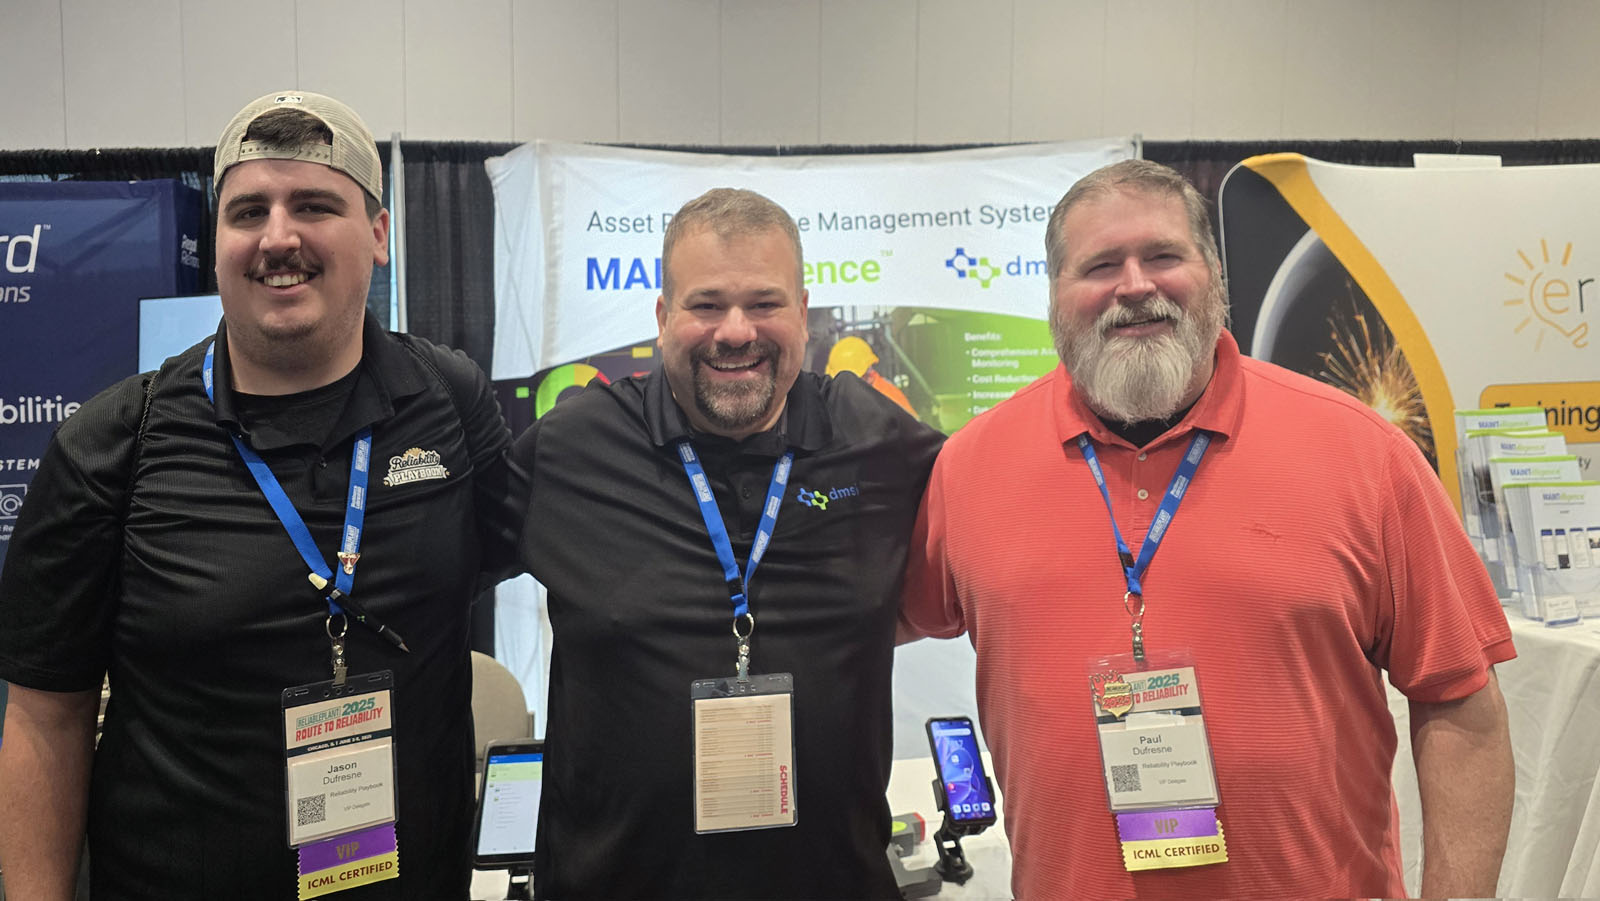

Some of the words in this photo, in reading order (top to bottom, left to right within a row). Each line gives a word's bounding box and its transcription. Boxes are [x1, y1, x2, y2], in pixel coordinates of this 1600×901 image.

[586, 210, 654, 234] Asset
[818, 207, 973, 235] Management
[391, 452, 441, 469] Reliability
[393, 467, 443, 483] PLAYBOOK
[1147, 673, 1180, 690] 2025
[1142, 683, 1189, 703] RELIABILITY
[341, 697, 376, 716] 2025
[295, 723, 323, 742] ROUTE
[324, 720, 335, 733] TO
[335, 706, 383, 730] RELIABILITY
[1139, 734, 1162, 744] Paul
[1132, 745, 1173, 756] Dufresne
[327, 761, 358, 774] Jason
[322, 771, 363, 785] Dufresne
[779, 764, 788, 814] SCHEDULE
[1154, 818, 1179, 835] VIP
[336, 841, 360, 860] VIP
[1133, 849, 1162, 860] ICML
[1164, 843, 1220, 857] CERTIFIED
[307, 875, 336, 890] ICML
[338, 861, 393, 881] CERTIFIED
